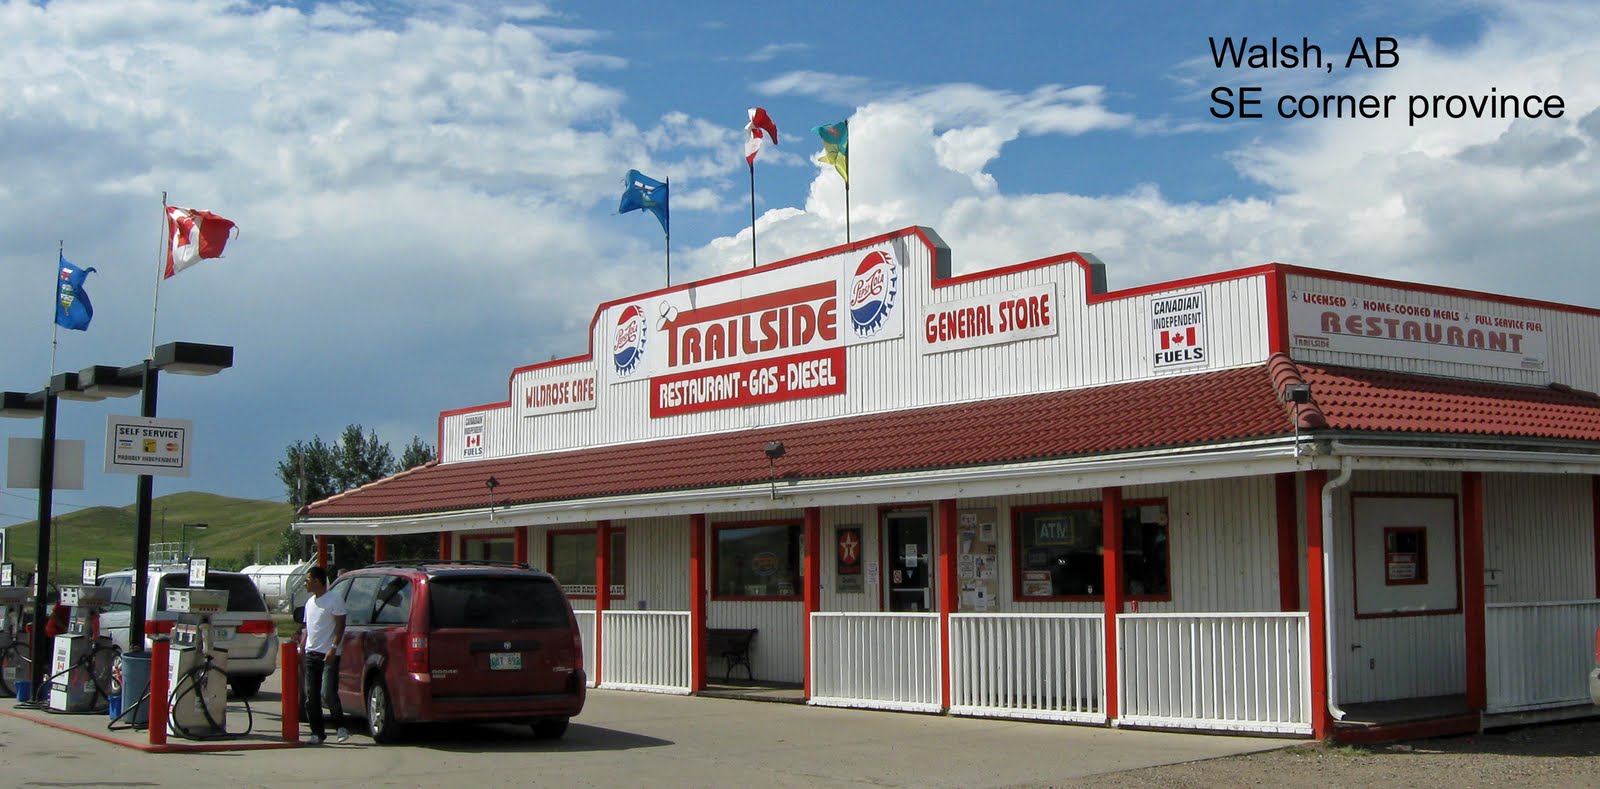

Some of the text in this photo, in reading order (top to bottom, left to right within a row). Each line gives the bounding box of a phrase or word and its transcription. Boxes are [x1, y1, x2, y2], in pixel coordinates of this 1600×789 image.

[1154, 295, 1200, 315] CANADIAN
[1303, 292, 1543, 332] LICENSED HOME-COOKED MEALS FULL SERVICE FUEL
[658, 280, 837, 367] TRAILSIDE
[926, 293, 1050, 344] GENERAL STORE
[1153, 312, 1202, 330] INDEPENDENT
[1294, 335, 1330, 348] TRAILSIDE
[1321, 311, 1523, 352] RESTAURANT
[1155, 347, 1203, 364] FUELS
[525, 377, 594, 408] WILDROSE CAFE
[119, 427, 179, 438] SELF SERVICE
[463, 447, 483, 456] FUELS
